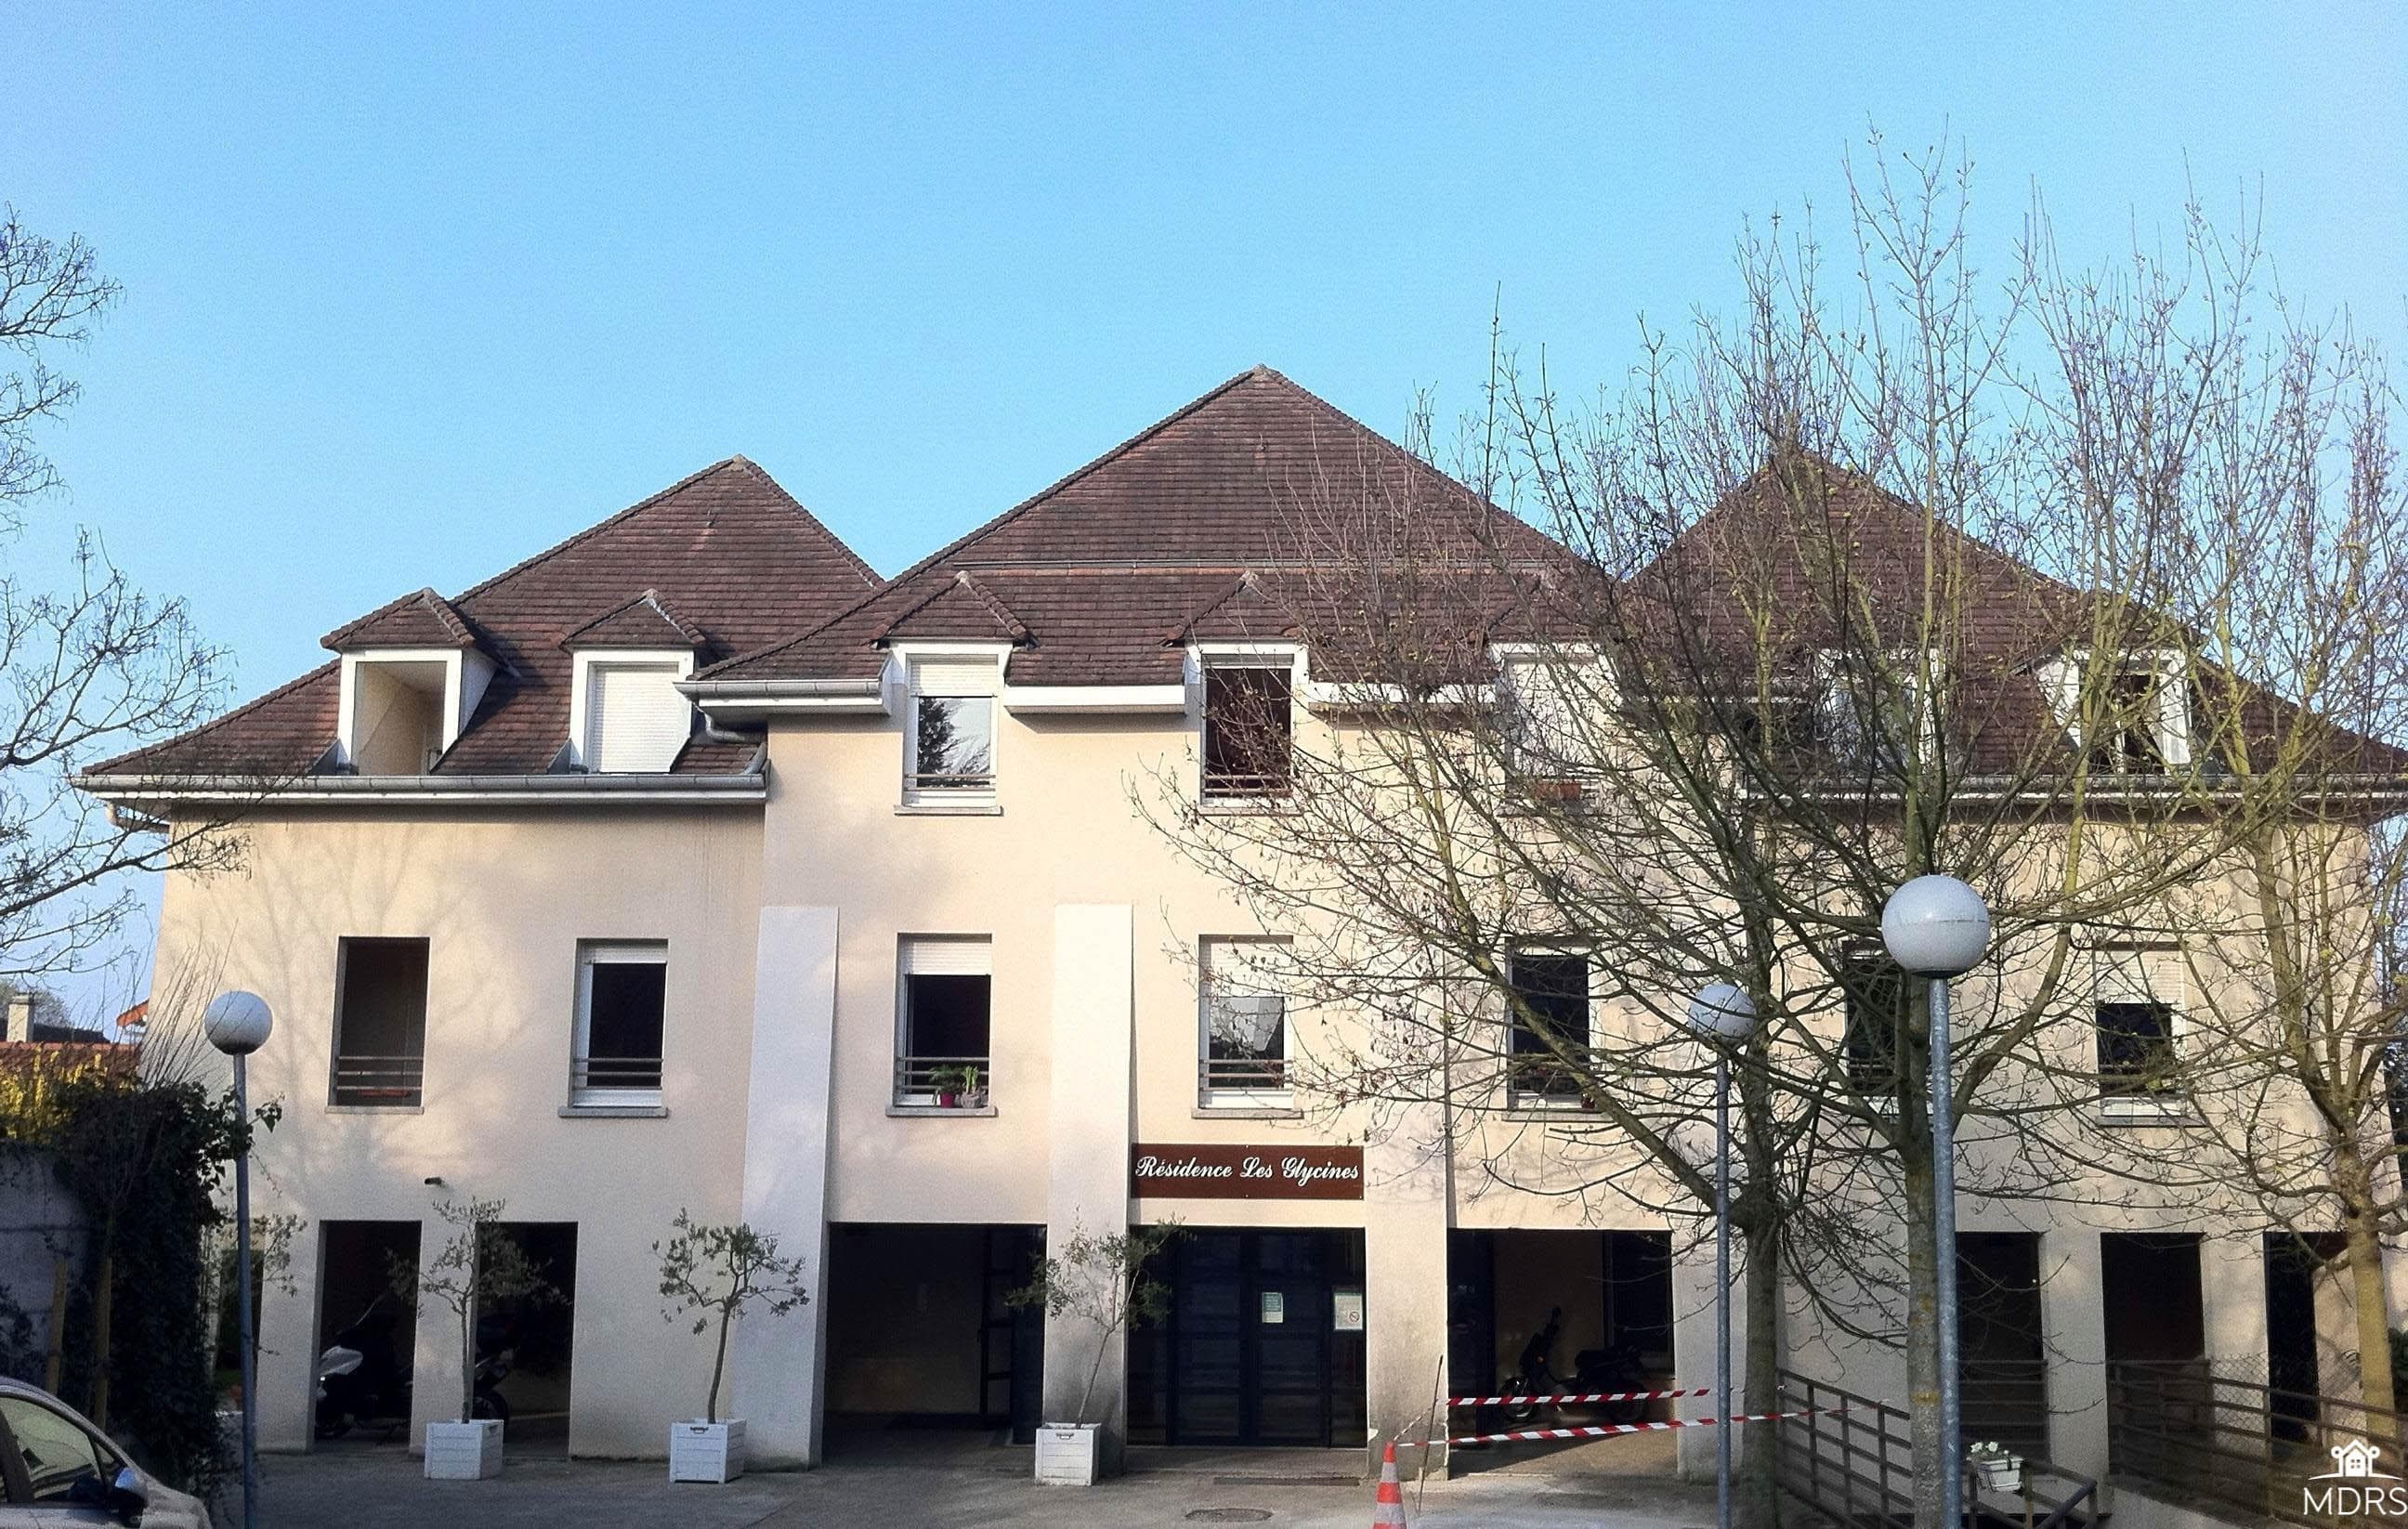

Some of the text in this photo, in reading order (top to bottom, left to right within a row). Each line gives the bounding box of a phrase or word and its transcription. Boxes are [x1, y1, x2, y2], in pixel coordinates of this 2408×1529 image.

[1135, 1156, 1358, 1187] Résidence Les Glycines
